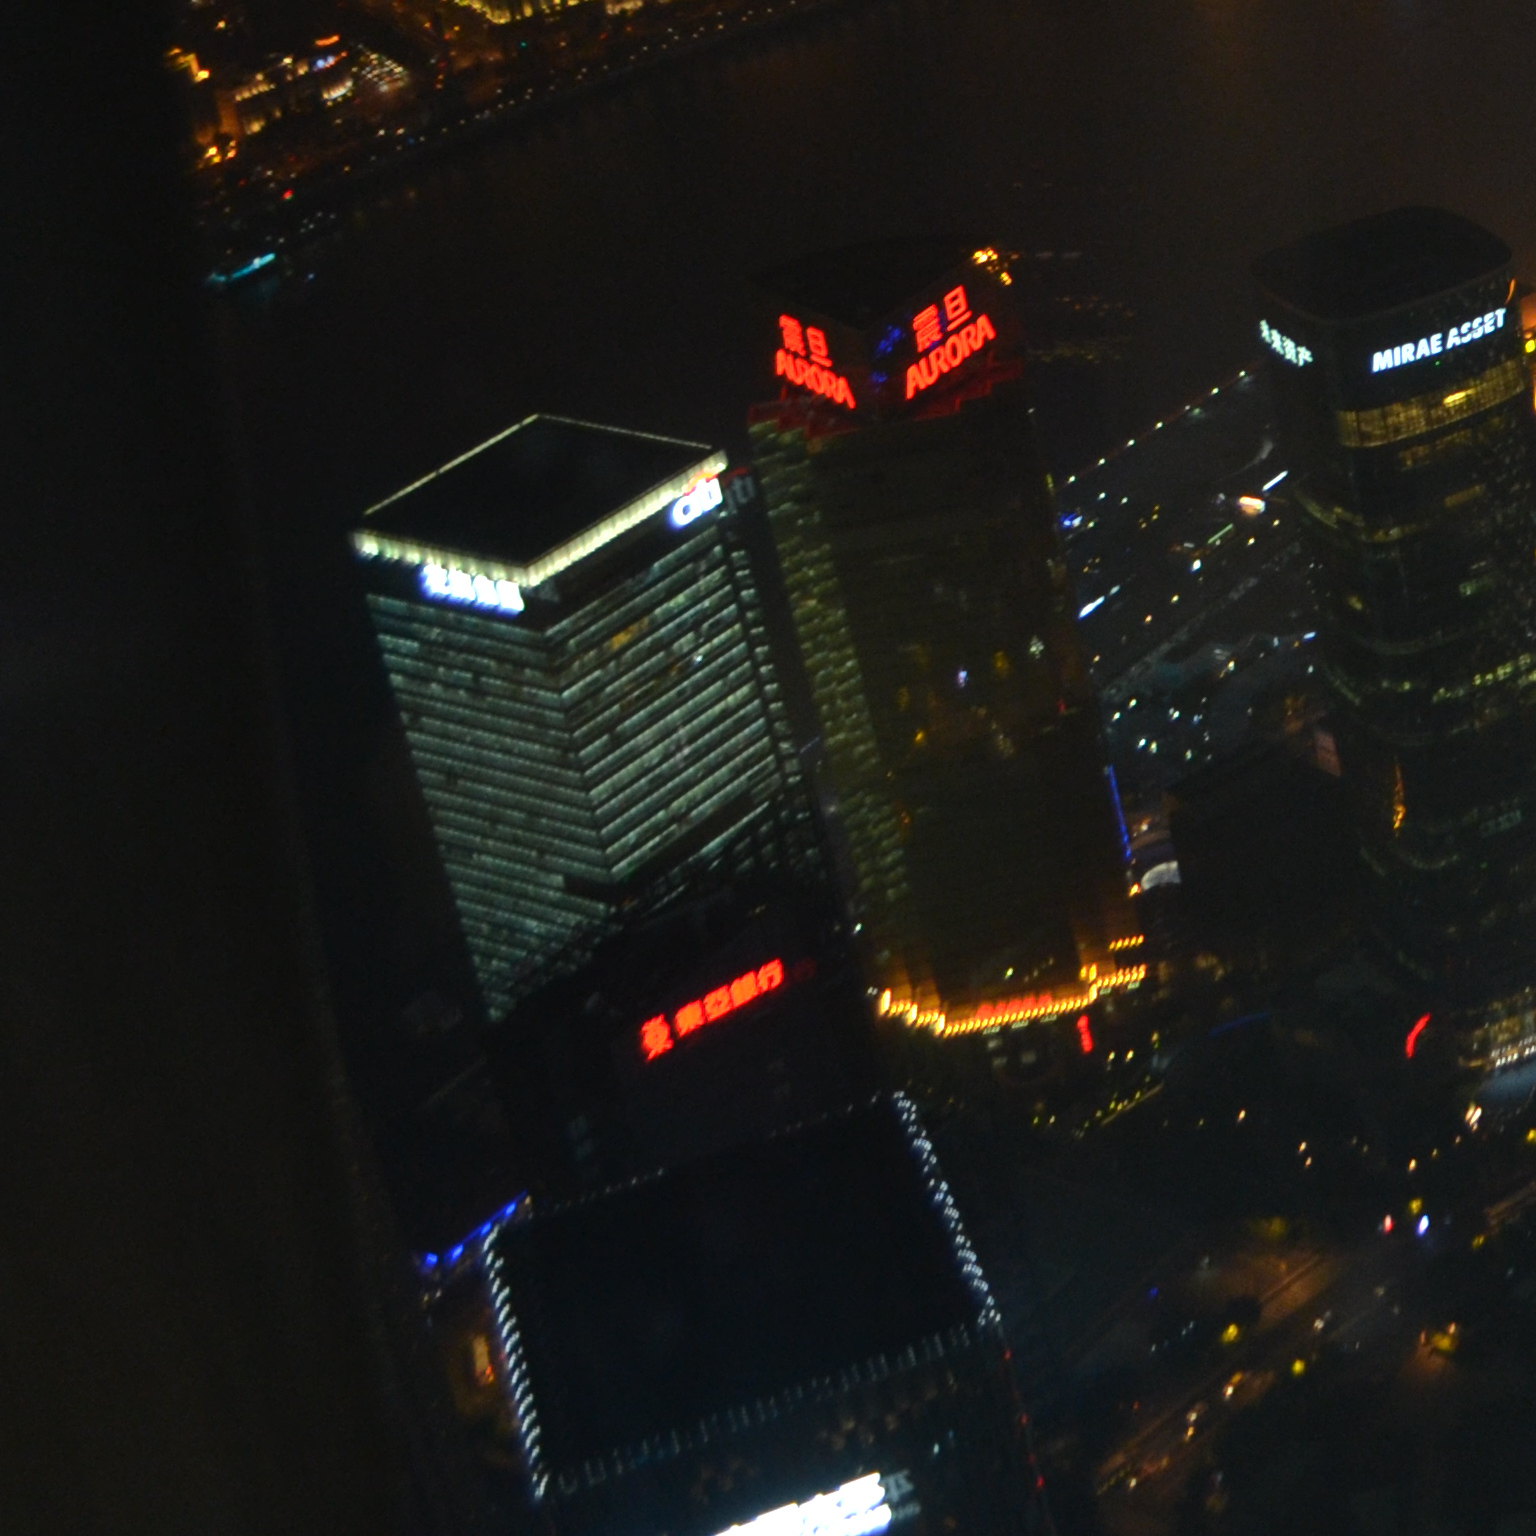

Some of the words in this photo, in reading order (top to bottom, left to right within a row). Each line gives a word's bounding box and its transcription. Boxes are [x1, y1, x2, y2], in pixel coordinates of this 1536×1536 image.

[912, 285, 973, 353] 震旦
[1371, 332, 1443, 373] MIRAE
[1445, 307, 1507, 350] ASSET
[775, 349, 857, 409] AURORA
[905, 313, 997, 401] AURORA
